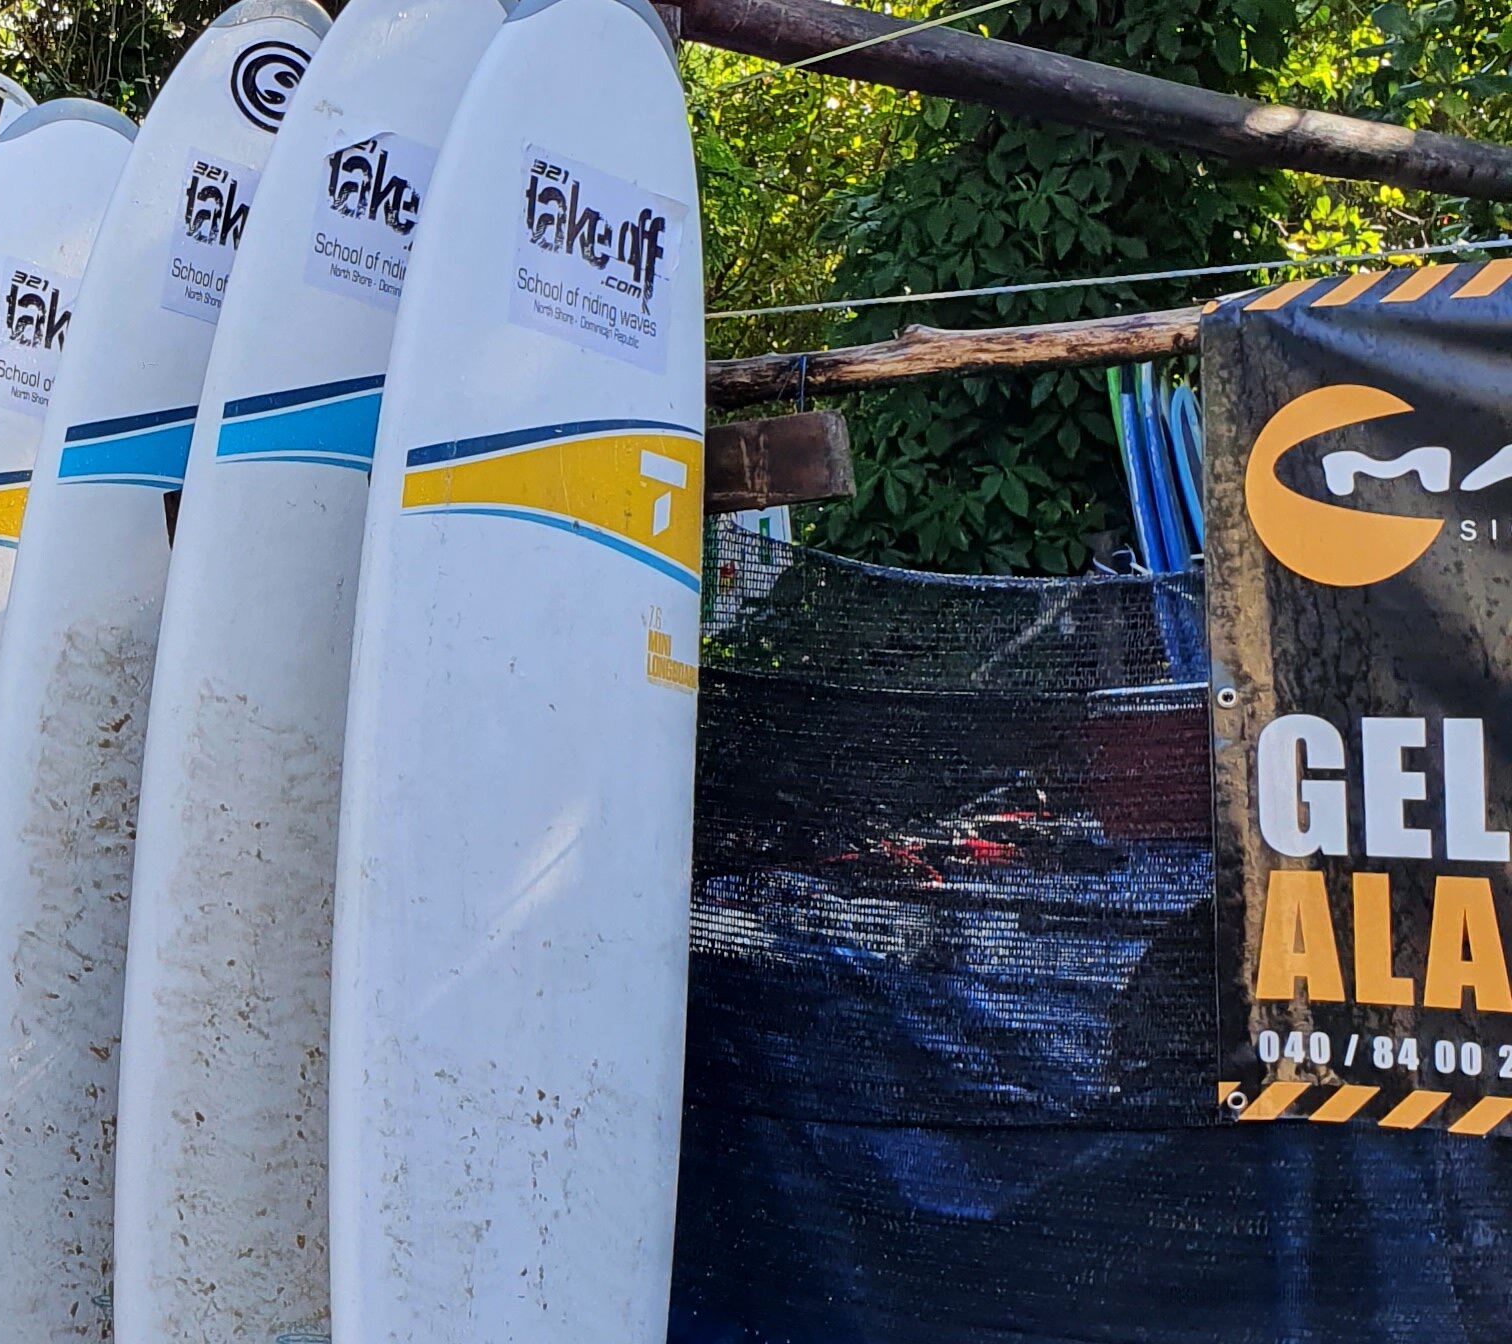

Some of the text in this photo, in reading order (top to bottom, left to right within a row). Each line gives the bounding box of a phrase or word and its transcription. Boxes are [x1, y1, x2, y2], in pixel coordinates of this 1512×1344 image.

[193, 160, 229, 183] 321
[530, 159, 570, 185] 321
[314, 232, 363, 266] School
[365, 252, 381, 270] of
[12, 270, 49, 291] 321
[172, 258, 214, 288] School
[330, 263, 350, 280] North
[351, 270, 373, 287] Shore
[601, 275, 643, 299] .com
[517, 267, 657, 337] School of riding waves
[533, 298, 553, 317] North
[11, 385, 30, 401] North
[648, 629, 671, 657] MINI
[1257, 713, 1511, 862] GEL
[1255, 870, 1512, 1013] ALA
[1258, 1030, 1331, 1065] 040
[1372, 1036, 1420, 1070] 84
[1434, 1039, 1483, 1077] 00
